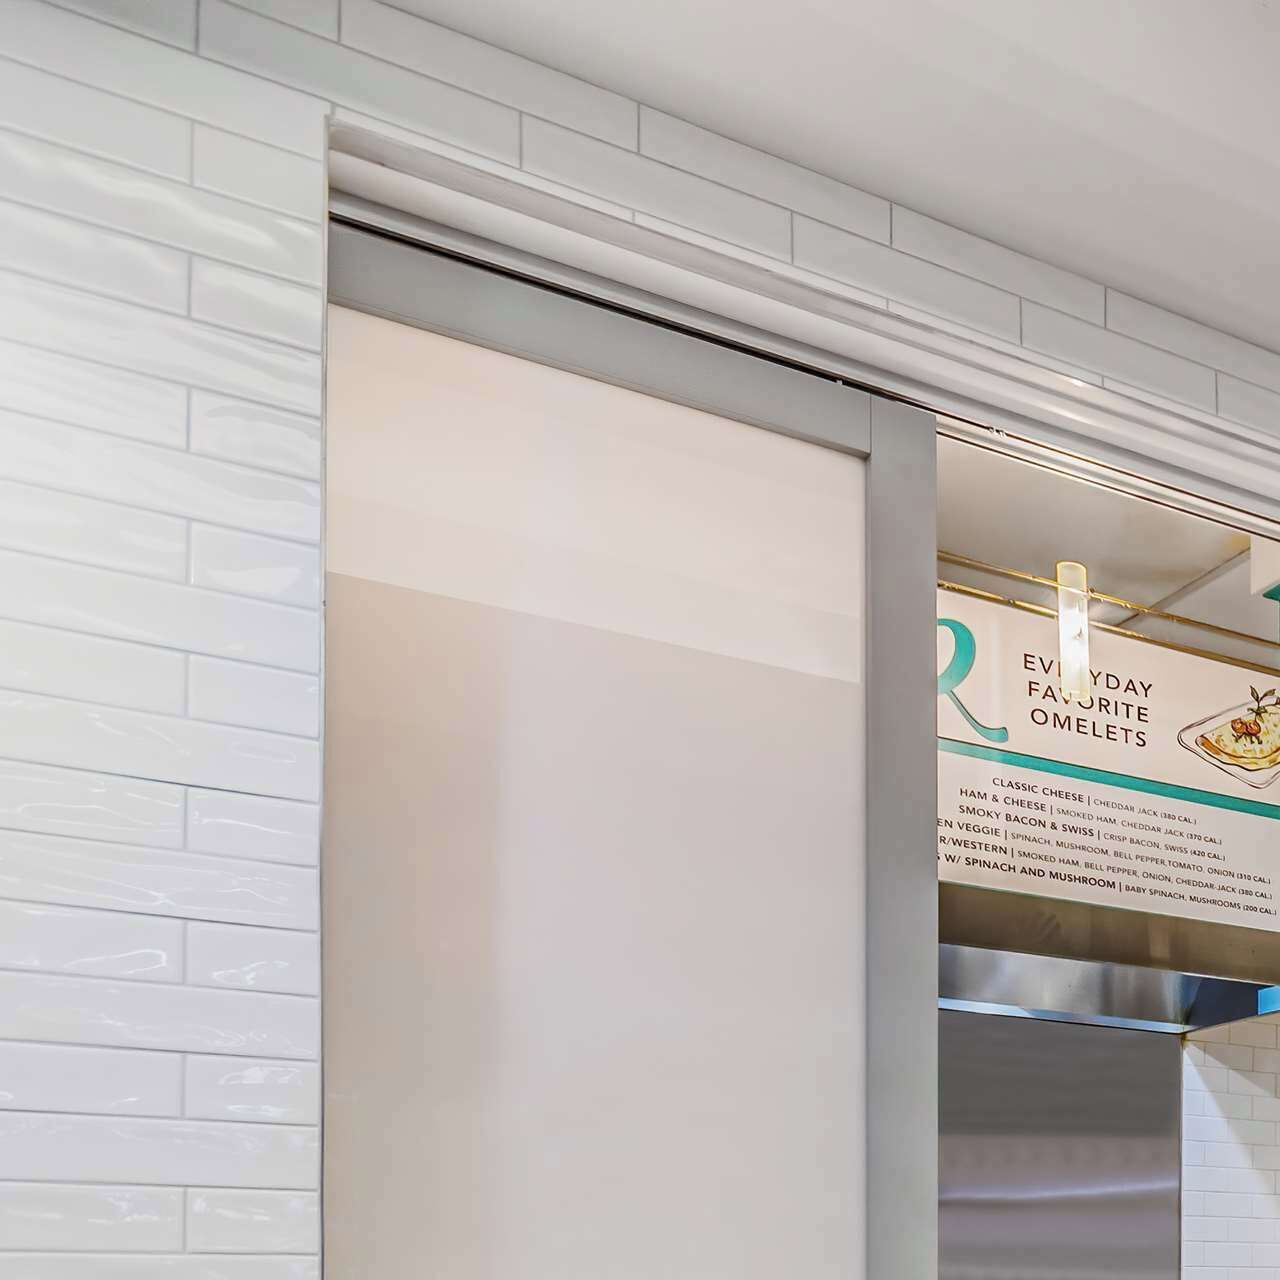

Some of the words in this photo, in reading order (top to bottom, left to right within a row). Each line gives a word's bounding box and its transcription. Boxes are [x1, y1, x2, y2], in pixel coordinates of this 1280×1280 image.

[1023, 653, 1152, 698] EVYDAY
[1030, 708, 1147, 747] OMELETS
[960, 788, 987, 800] HAM
[992, 794, 999, 803] &
[1003, 796, 1047, 812] CHEESE
[1056, 807, 1094, 821] SMOKED
[1121, 820, 1161, 833] CHEDDAR
[1163, 827, 1185, 838] JACK
[992, 777, 1039, 794] CLASSIC
[1042, 787, 1084, 803] CHEESE
[1093, 798, 1135, 813] CHEDDAR
[1137, 806, 1158, 817] JACK
[957, 821, 1001, 837] VEGGIE
[1113, 850, 1133, 861] BELL
[1207, 867, 1235, 878] ONION
[959, 804, 1001, 820] SMOKY
[1005, 813, 1047, 829] BACON
[1050, 821, 1058, 831] &
[1061, 823, 1094, 837] SWISS
[1103, 832, 1127, 843] CRISP
[1164, 843, 1188, 854] SWISS
[944, 853, 961, 864] W/
[965, 856, 1016, 873] SPINACH
[1020, 866, 1046, 878] AND
[1049, 870, 1116, 889] MUSHROOM
[1124, 884, 1147, 895] BABY
[1189, 895, 1241, 910] MUSHROOMS
[1017, 850, 1056, 863] SMOKED
[1084, 861, 1105, 872] BELL
